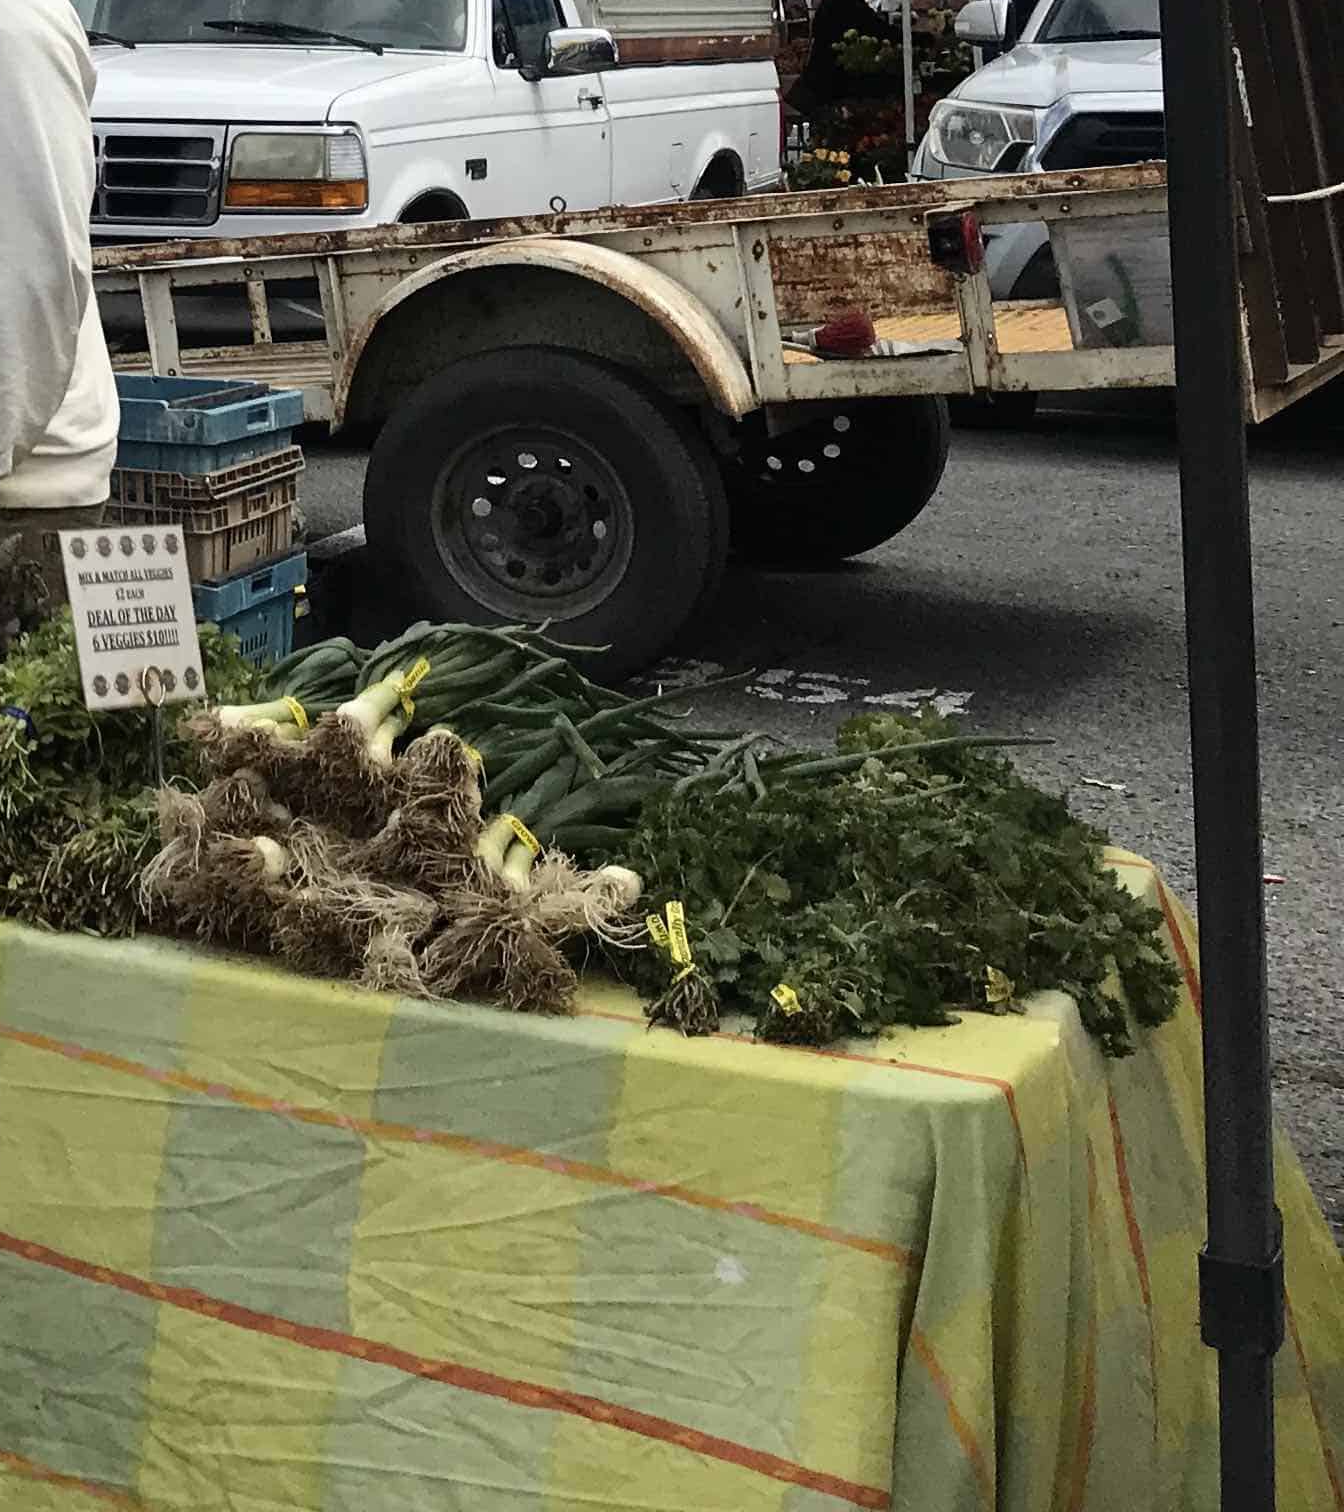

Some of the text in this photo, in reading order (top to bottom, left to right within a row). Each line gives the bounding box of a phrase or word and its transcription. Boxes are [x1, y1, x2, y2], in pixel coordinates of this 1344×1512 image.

[78, 571, 94, 585] MIX
[102, 569, 128, 584] MATCH
[130, 568, 143, 582] ALL
[144, 567, 173, 581] VEGGIES
[126, 588, 144, 600] EACH
[87, 604, 177, 628] DEAL OF THE DAY
[92, 634, 100, 652] 6
[101, 631, 146, 650] VEGGIES
